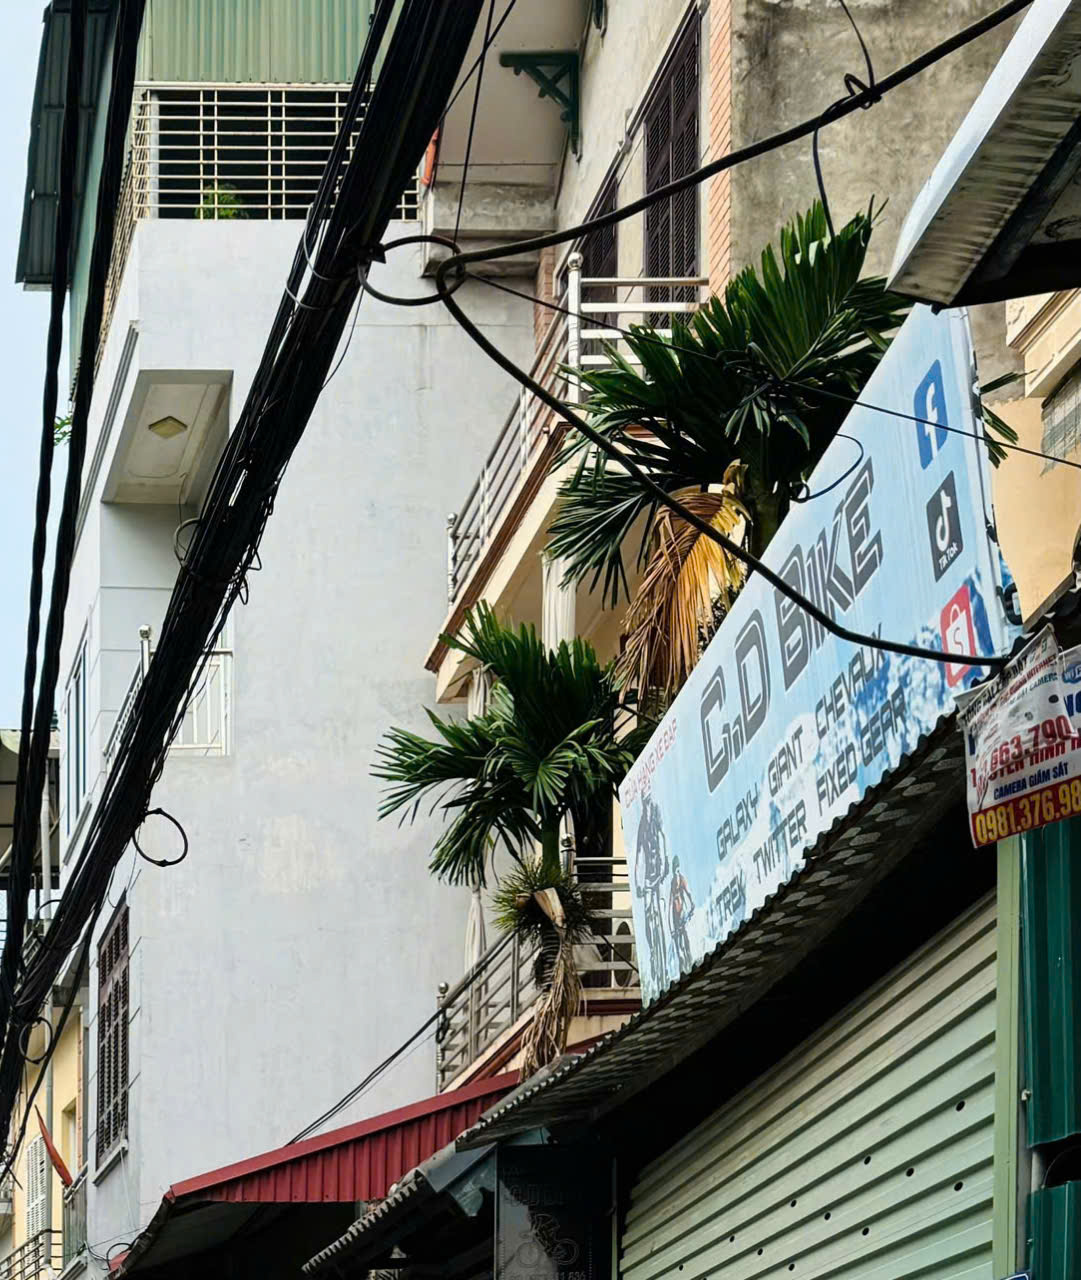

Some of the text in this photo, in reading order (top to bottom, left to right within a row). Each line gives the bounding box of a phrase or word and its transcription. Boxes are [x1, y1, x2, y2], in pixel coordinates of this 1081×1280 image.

[773, 456, 884, 692] BIKE
[715, 685, 907, 923] TREK TWITTER FIXED GEAR
[716, 622, 886, 862] GALAXY GIANT CHEVAUX
[994, 777, 1027, 800] CAMERA
[1052, 761, 1068, 779] SÁT
